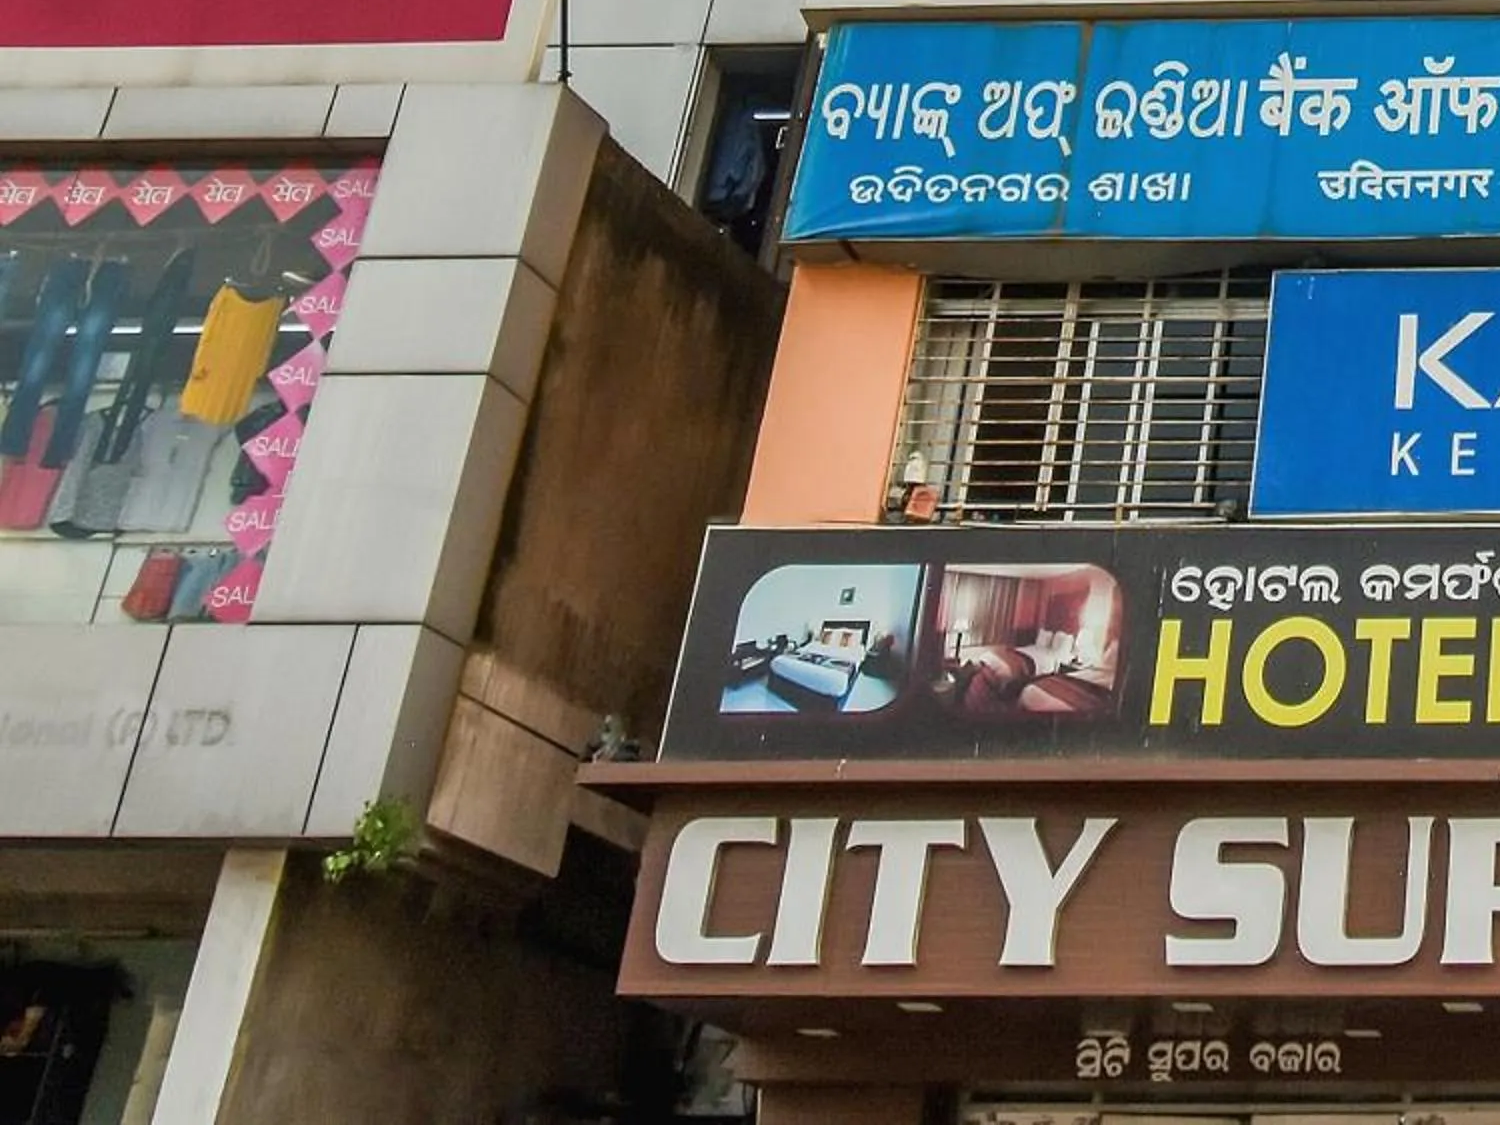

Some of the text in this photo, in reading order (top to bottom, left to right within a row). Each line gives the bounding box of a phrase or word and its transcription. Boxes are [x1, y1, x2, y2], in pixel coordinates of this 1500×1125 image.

[1258, 52, 1358, 137] बैंक
[132, 181, 174, 206] सेल
[204, 179, 245, 204] सेल
[271, 177, 314, 203] सेल
[1087, 170, 1192, 203] ଶାଖା
[1316, 159, 1494, 201] उदितनगर
[653, 815, 1119, 967] CITY
